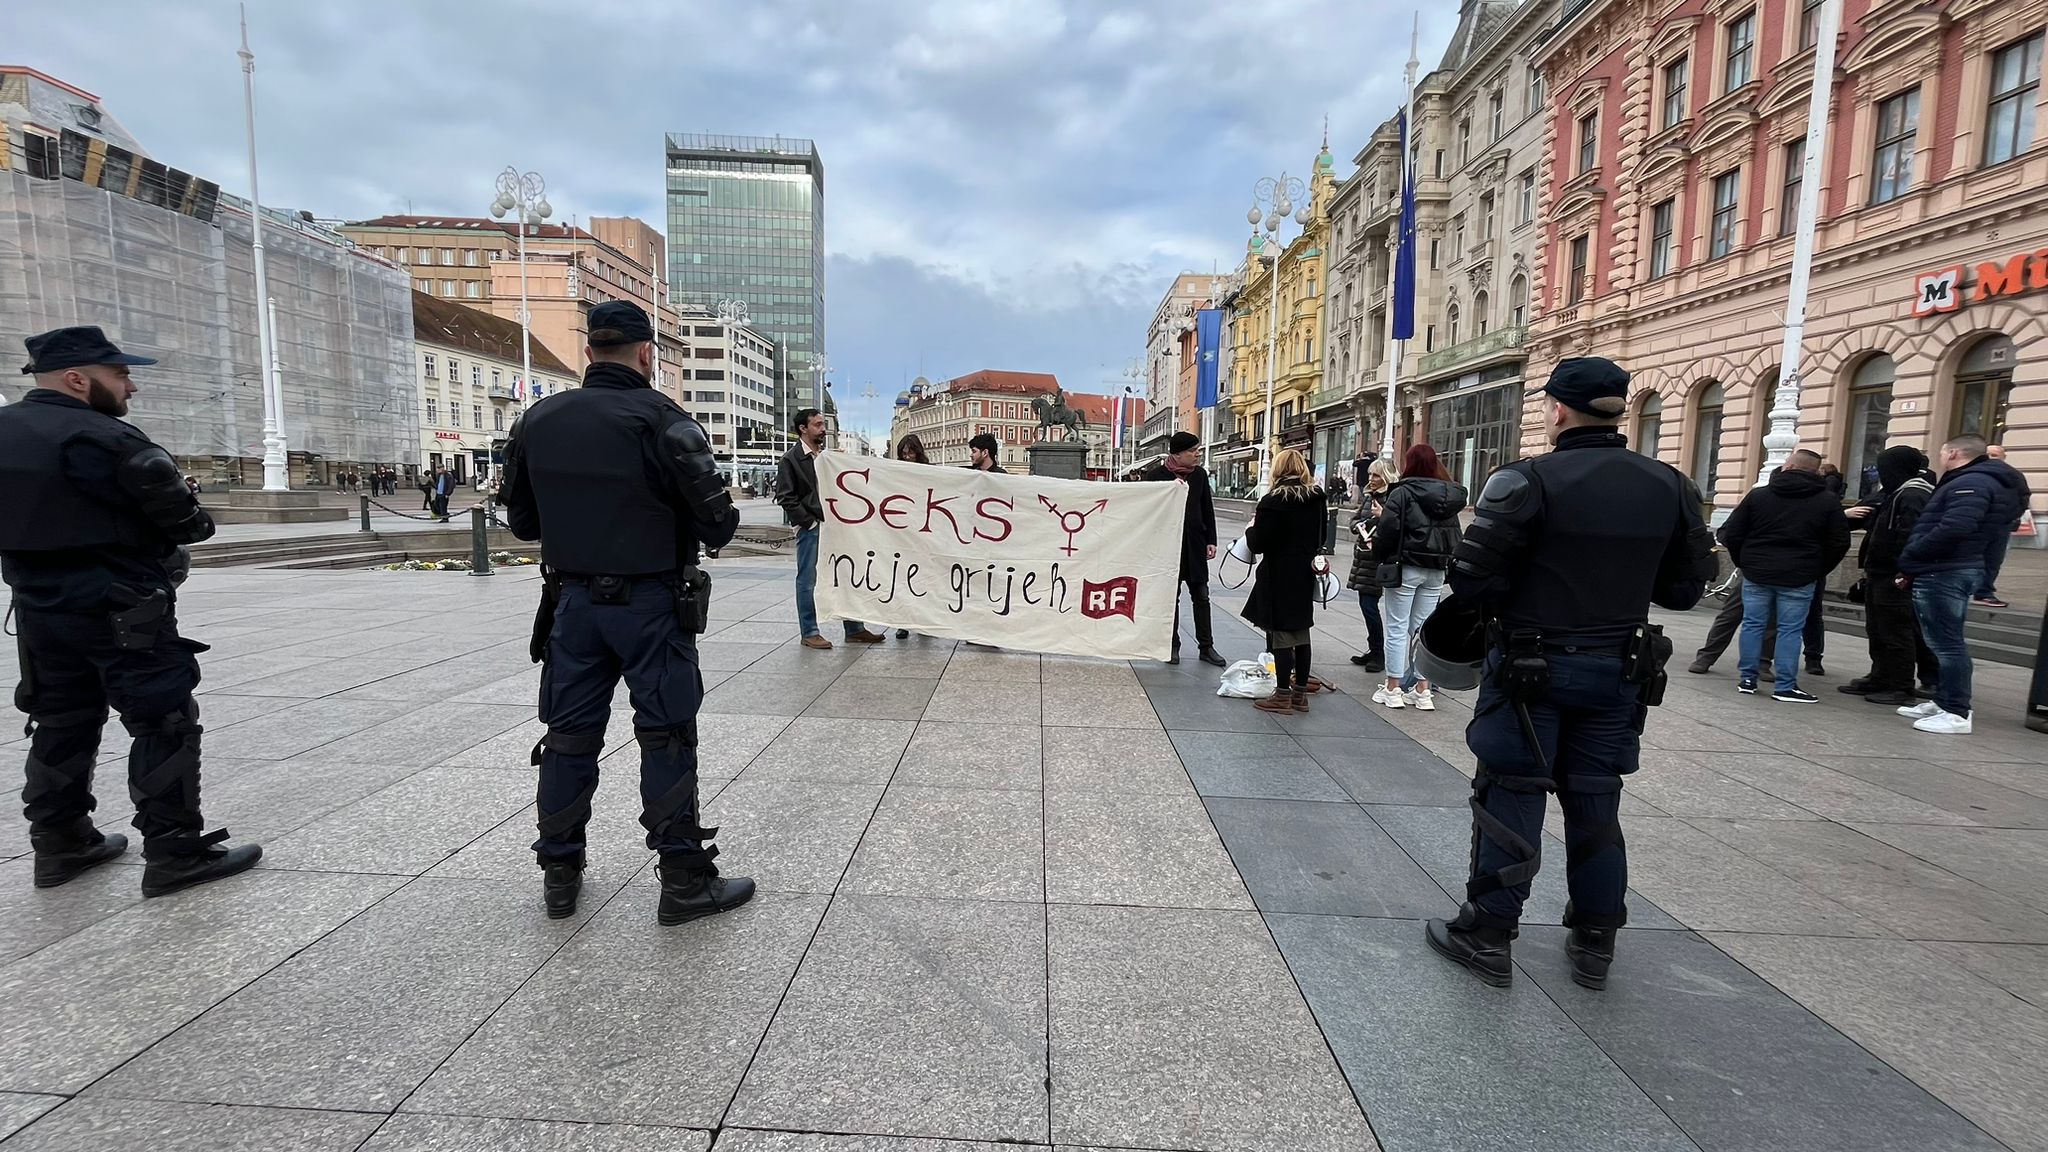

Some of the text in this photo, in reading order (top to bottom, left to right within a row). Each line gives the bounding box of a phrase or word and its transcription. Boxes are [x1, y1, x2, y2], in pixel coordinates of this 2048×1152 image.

[1923, 280, 1949, 303] M
[828, 550, 1073, 617] nije grijeh
[1089, 586, 1128, 612] RF
